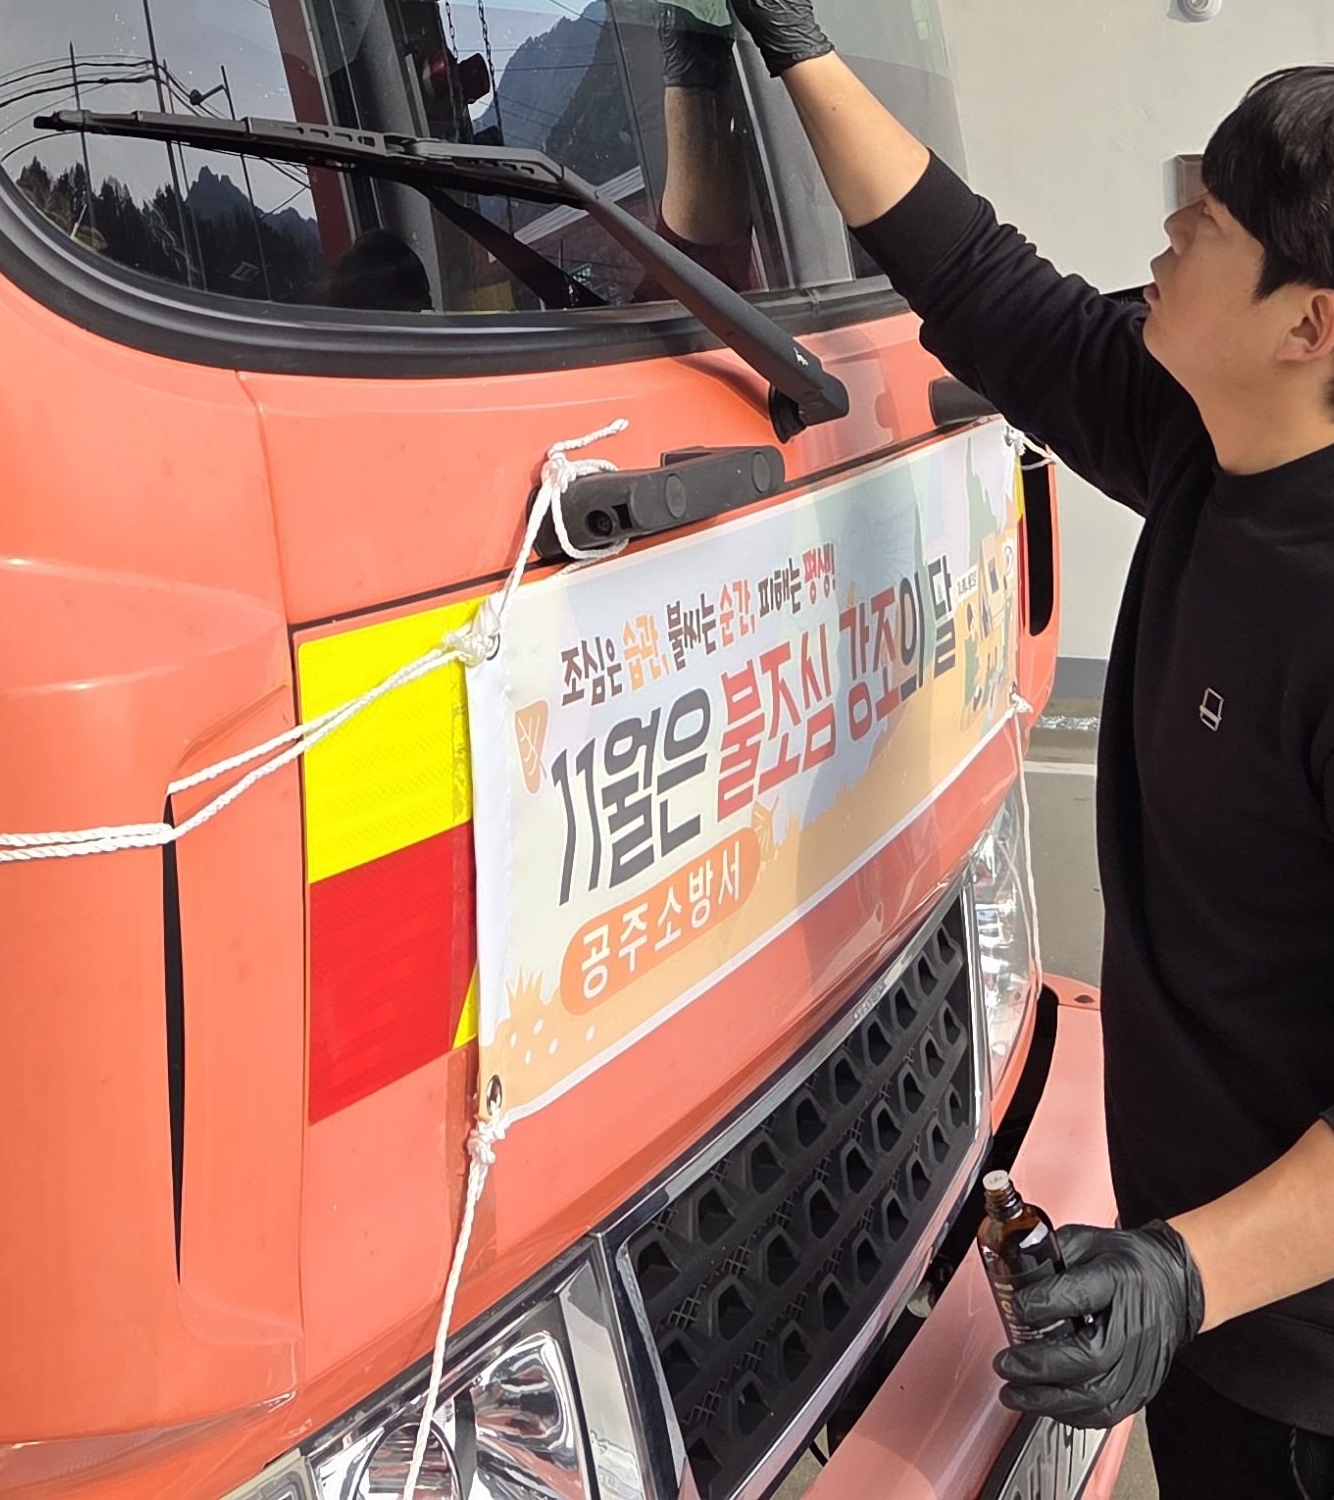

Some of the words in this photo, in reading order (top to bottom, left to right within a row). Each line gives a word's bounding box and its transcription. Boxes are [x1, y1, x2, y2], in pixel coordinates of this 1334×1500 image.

[561, 636, 623, 706] 조심은
[623, 614, 669, 691] 습관,
[667, 593, 716, 671] 불씨는
[719, 579, 756, 647] 순간,
[758, 557, 802, 618] 피해는
[802, 543, 836, 604] 평생!
[552, 691, 710, 905] 11월은
[717, 625, 837, 822] 불조심
[839, 572, 924, 741] 강조의
[928, 555, 956, 679] 달
[581, 855, 742, 999] 공주소방서
